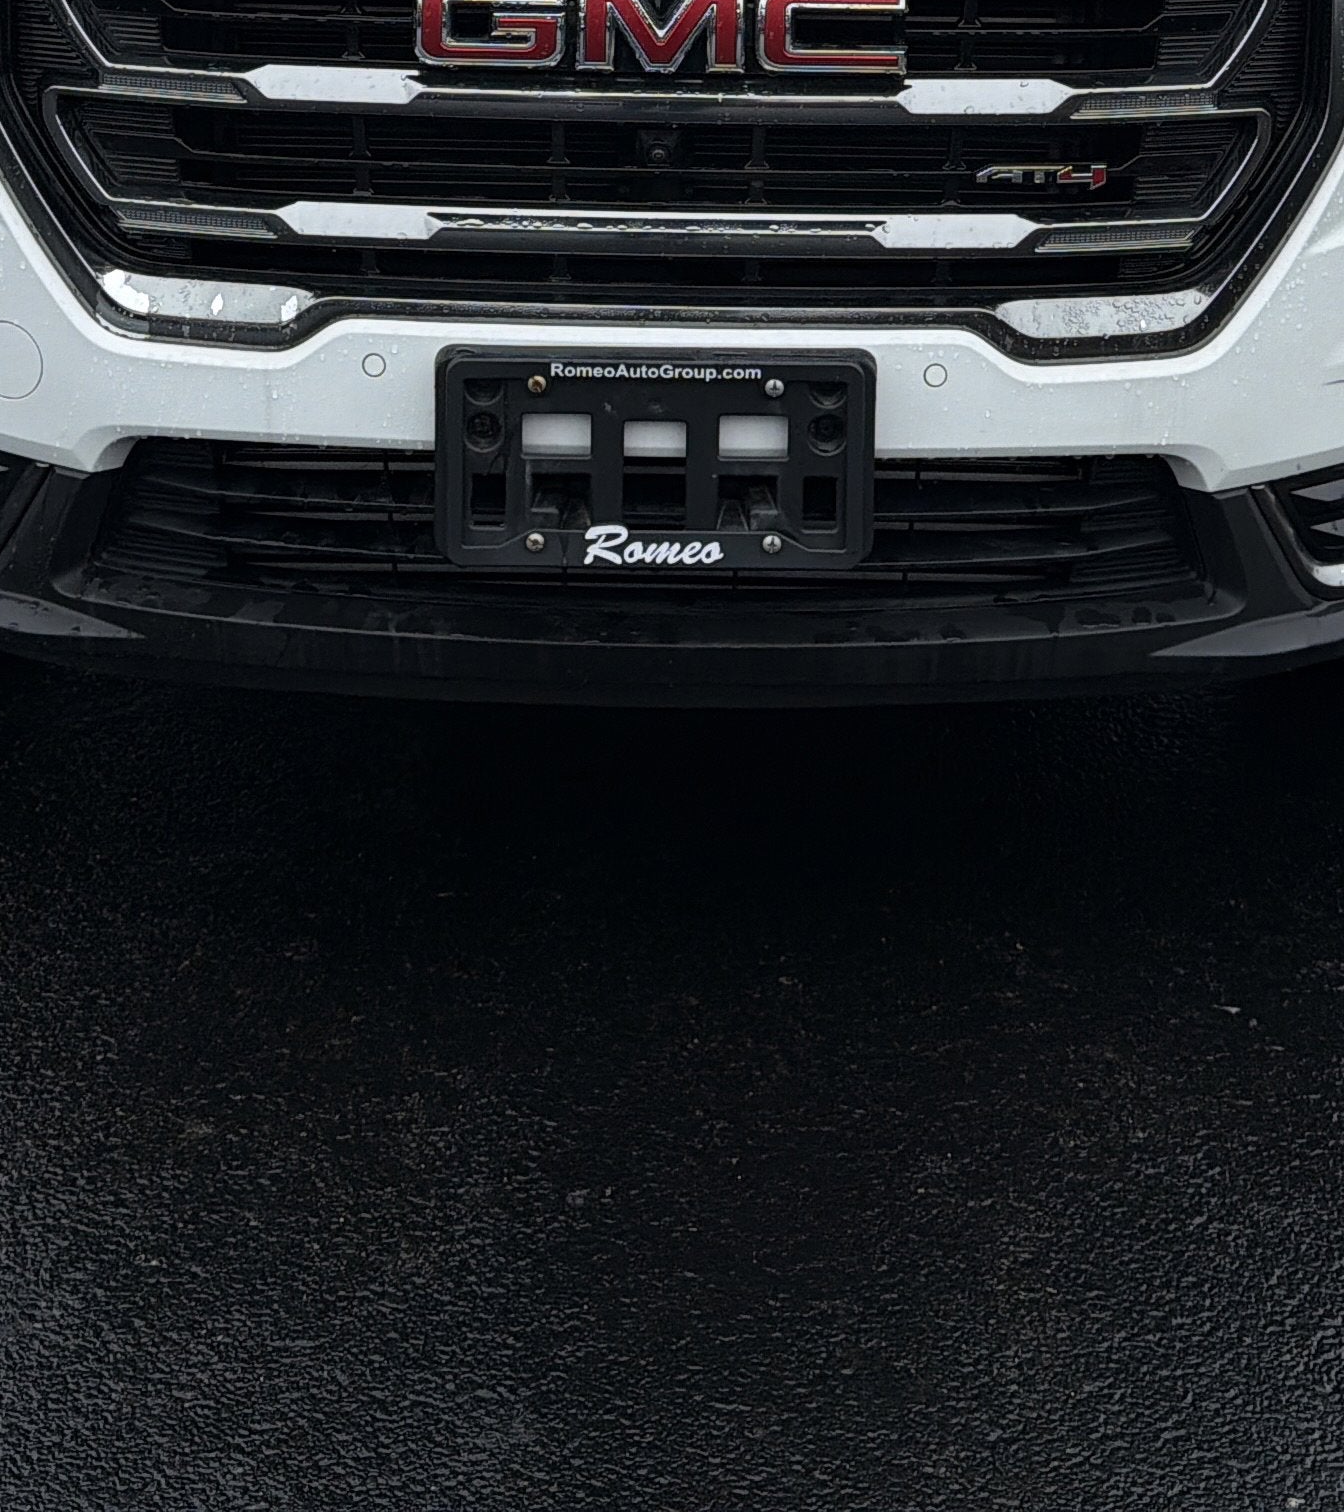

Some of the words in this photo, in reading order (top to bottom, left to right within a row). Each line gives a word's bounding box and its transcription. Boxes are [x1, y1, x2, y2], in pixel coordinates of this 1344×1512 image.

[975, 164, 1108, 190] AT4
[550, 362, 762, 383] RomeoAutoGroup.com
[583, 524, 725, 565] Romeo
